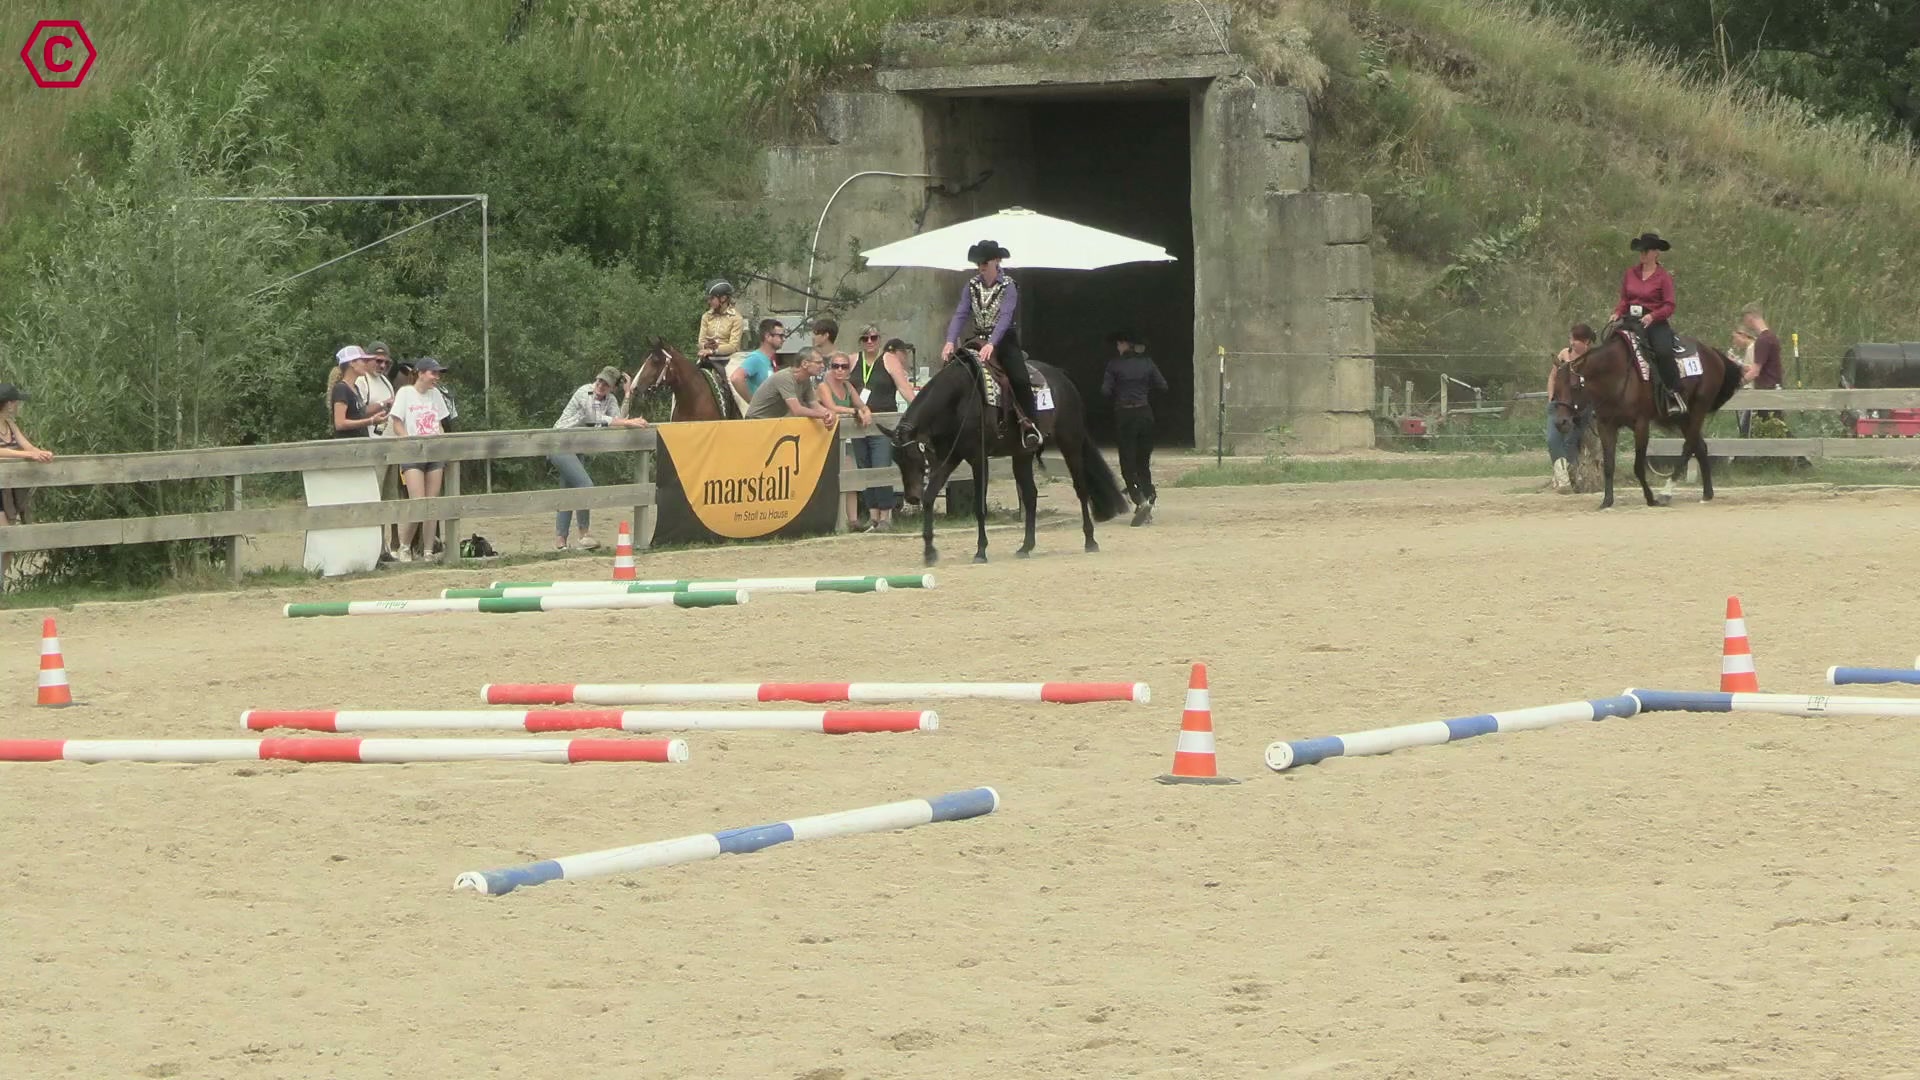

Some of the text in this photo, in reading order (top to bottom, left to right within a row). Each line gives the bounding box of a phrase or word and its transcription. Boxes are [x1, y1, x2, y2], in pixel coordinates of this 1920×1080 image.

[703, 466, 790, 505] marstall
[734, 509, 789, 521] Im Stall zu Hause
